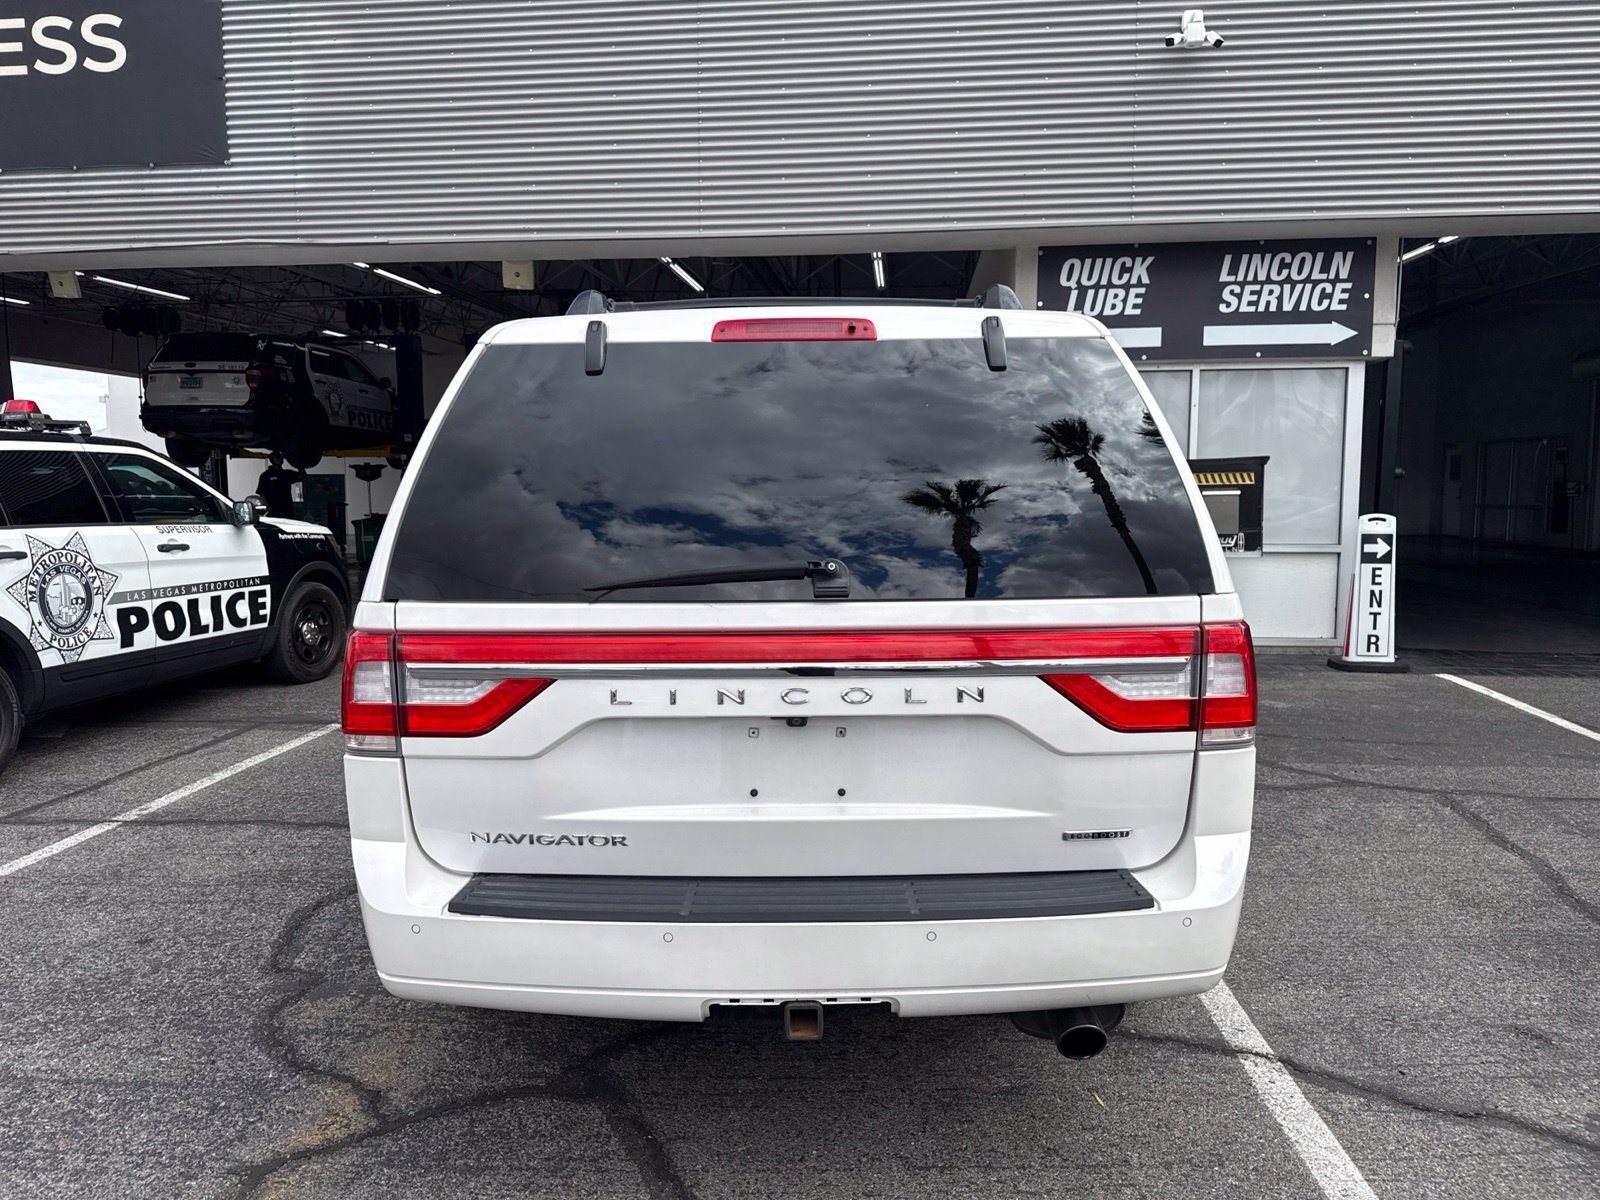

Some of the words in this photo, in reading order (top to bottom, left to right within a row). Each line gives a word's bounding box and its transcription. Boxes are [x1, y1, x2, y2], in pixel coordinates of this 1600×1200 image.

[1059, 256, 1155, 289] QUICK
[1218, 251, 1354, 282] LINCOLN
[1066, 287, 1147, 317] LUBE
[1218, 282, 1353, 313] SERVICE
[348, 410, 392, 431] POLICE
[155, 525, 213, 534] SUPERVISOR
[28, 551, 103, 603] METROPOLITAN
[40, 568, 58, 589] LAS
[59, 565, 87, 585] VEGAS
[127, 591, 147, 602] LAS
[152, 585, 187, 598] VEGAS
[190, 577, 261, 593] METROPOLITAN
[116, 588, 268, 649] POLICE
[1366, 567, 1383, 653] ENTR
[49, 627, 93, 649] POLICE
[610, 686, 984, 705] LINCOLN
[469, 832, 629, 847] NAVIGATOR
